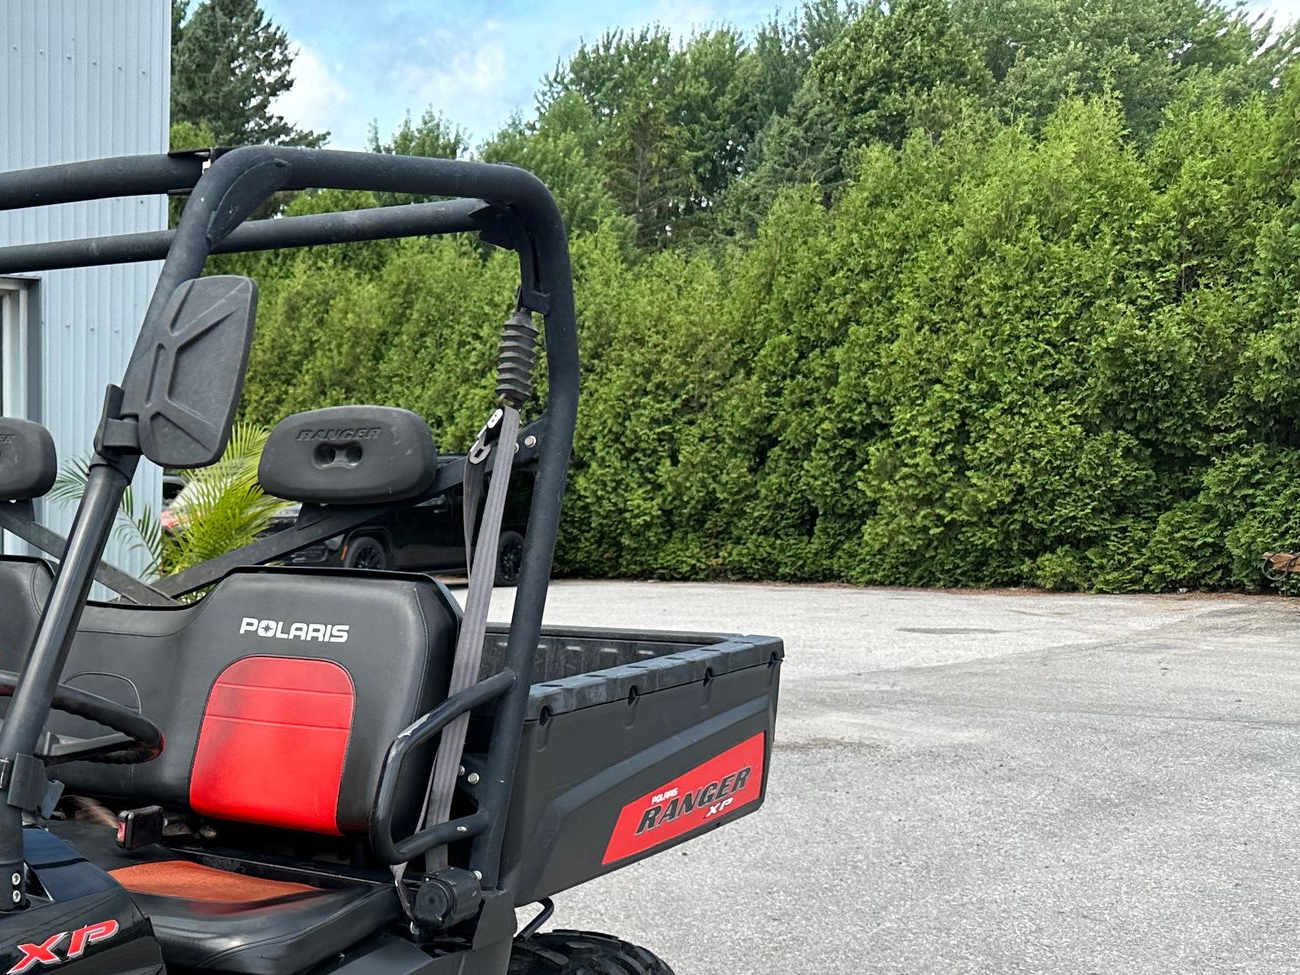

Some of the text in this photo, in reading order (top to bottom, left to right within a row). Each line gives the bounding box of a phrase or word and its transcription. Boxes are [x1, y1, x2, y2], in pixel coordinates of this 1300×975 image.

[296, 427, 382, 440] RANGER
[240, 617, 350, 643] POLARIS
[635, 766, 751, 836] RANGER
[652, 787, 679, 804] POLARIS
[705, 797, 734, 817] XP
